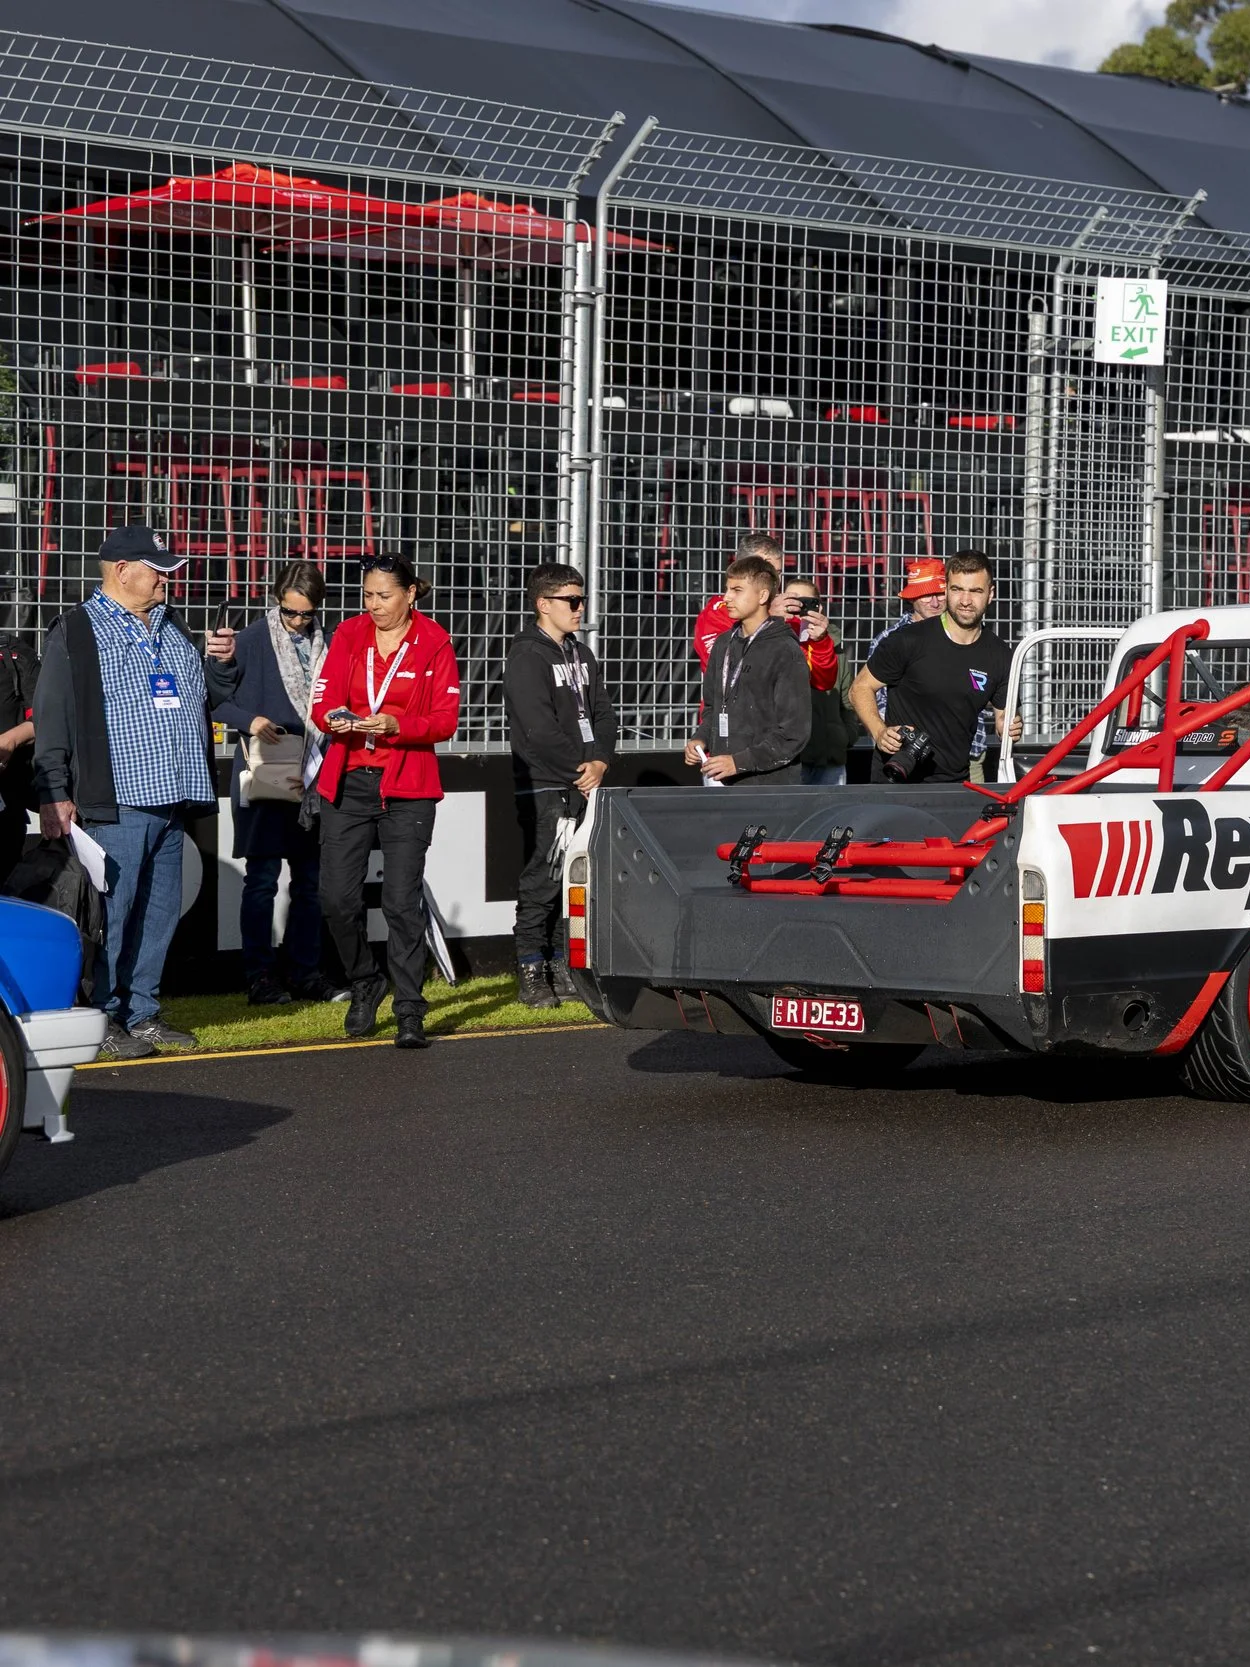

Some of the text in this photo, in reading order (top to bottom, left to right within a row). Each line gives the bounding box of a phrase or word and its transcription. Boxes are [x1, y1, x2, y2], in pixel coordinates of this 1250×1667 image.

[1111, 326, 1158, 343] EXIT
[1183, 732, 1214, 745] Repco
[775, 1000, 783, 1022] QLD
[786, 1000, 859, 1027] RIDE33
